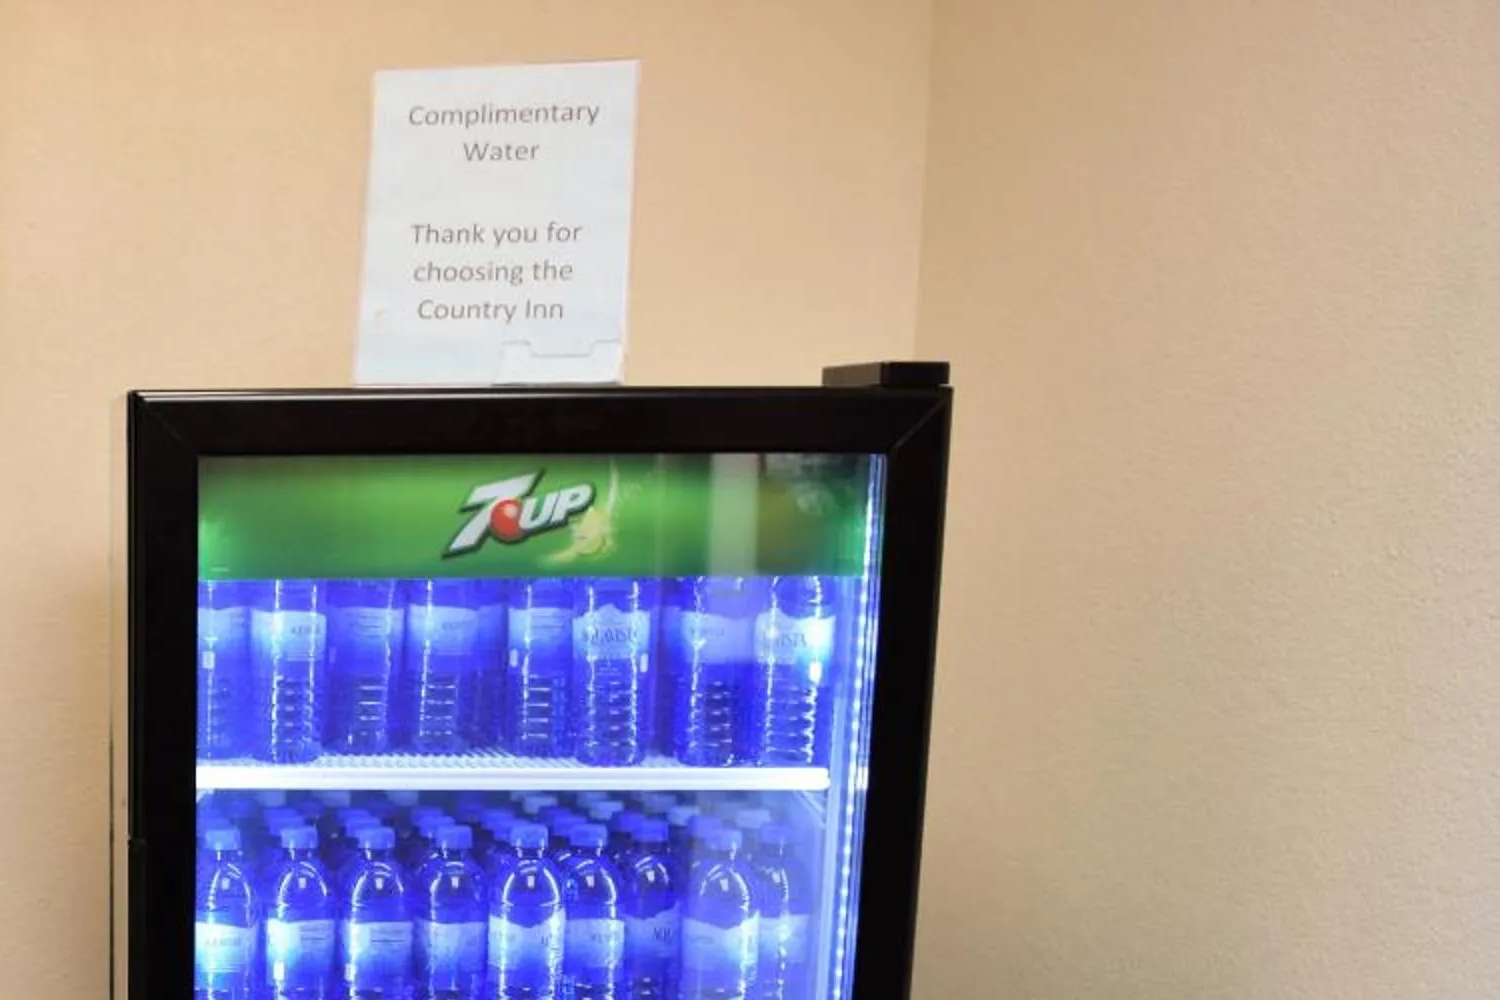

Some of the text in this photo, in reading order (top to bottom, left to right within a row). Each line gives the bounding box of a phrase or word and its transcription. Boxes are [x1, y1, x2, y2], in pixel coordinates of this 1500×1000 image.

[408, 104, 599, 128] Complimentary
[463, 142, 540, 162] Water
[410, 221, 583, 245] Thank you for
[413, 259, 574, 284] choosing the
[417, 298, 564, 323] Country Inn
